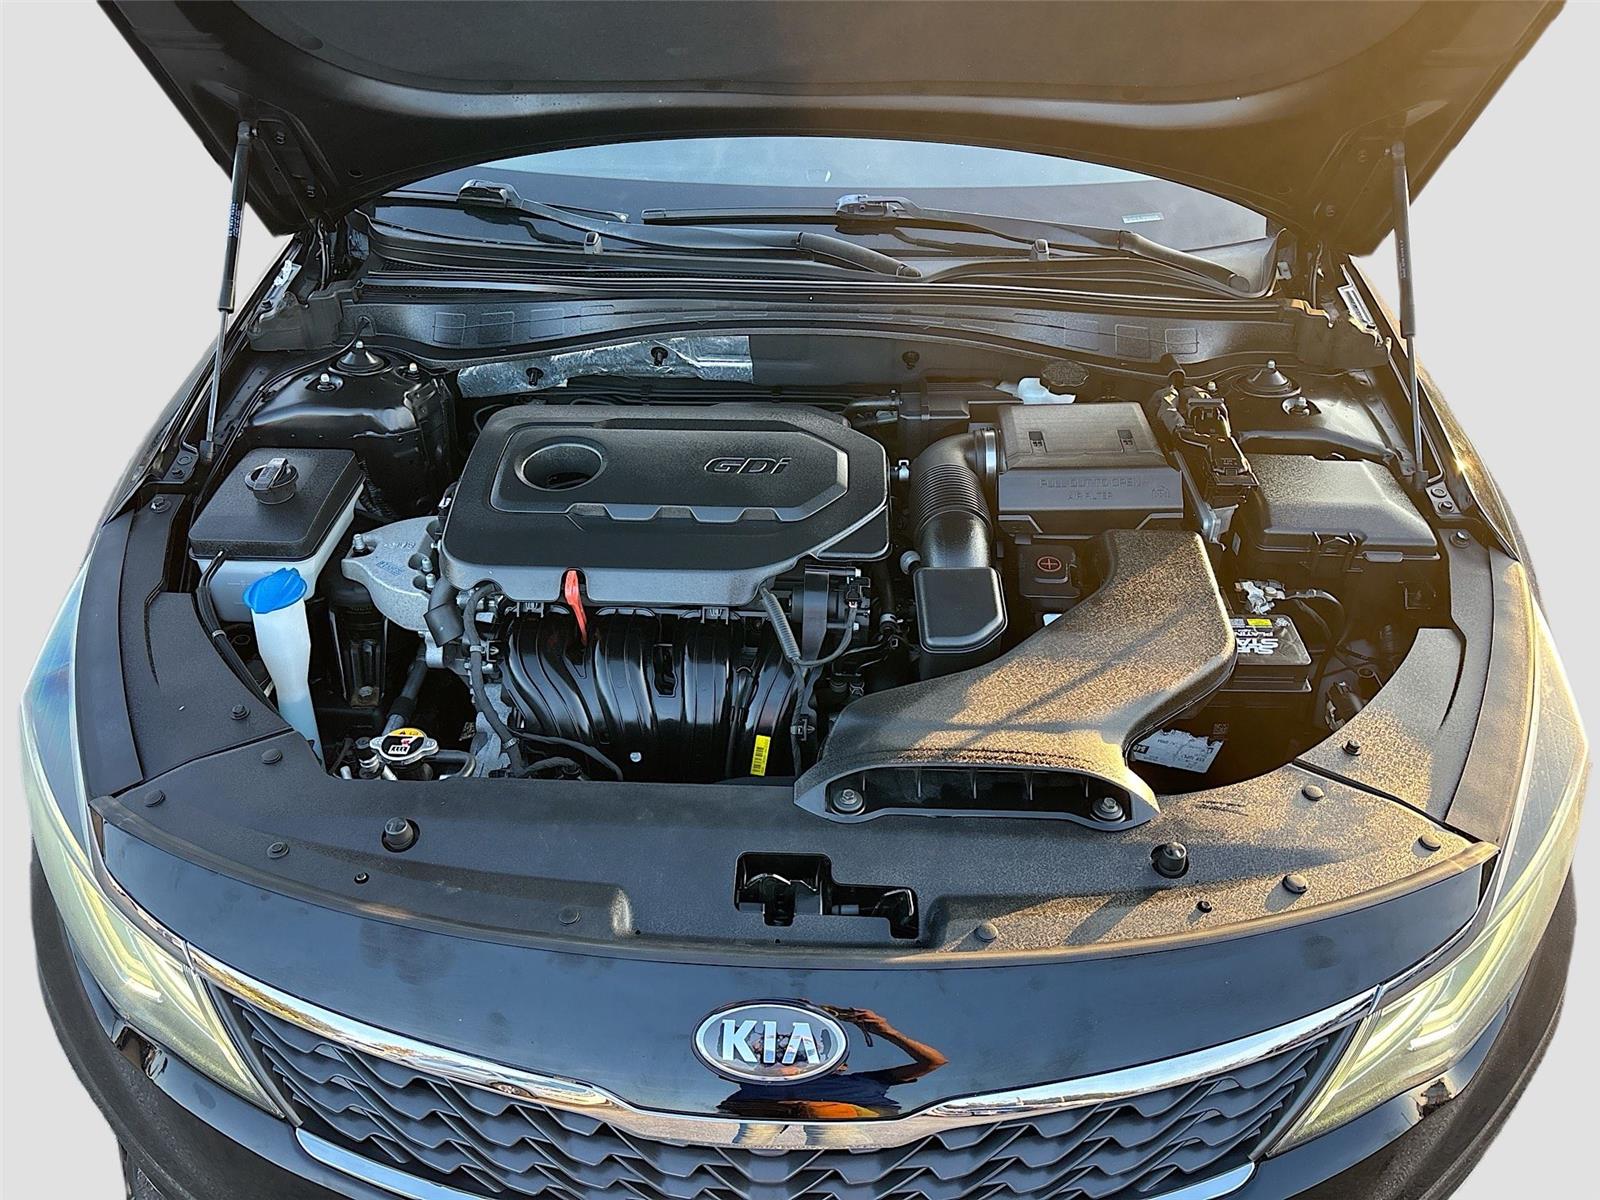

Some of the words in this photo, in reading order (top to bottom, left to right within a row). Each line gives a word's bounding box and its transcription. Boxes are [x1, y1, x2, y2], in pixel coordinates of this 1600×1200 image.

[704, 457, 792, 474] GDi
[1040, 479, 1067, 489] PULL
[1070, 479, 1091, 489] OUT
[1094, 479, 1109, 488] TO
[722, 1019, 820, 1064] KIA
